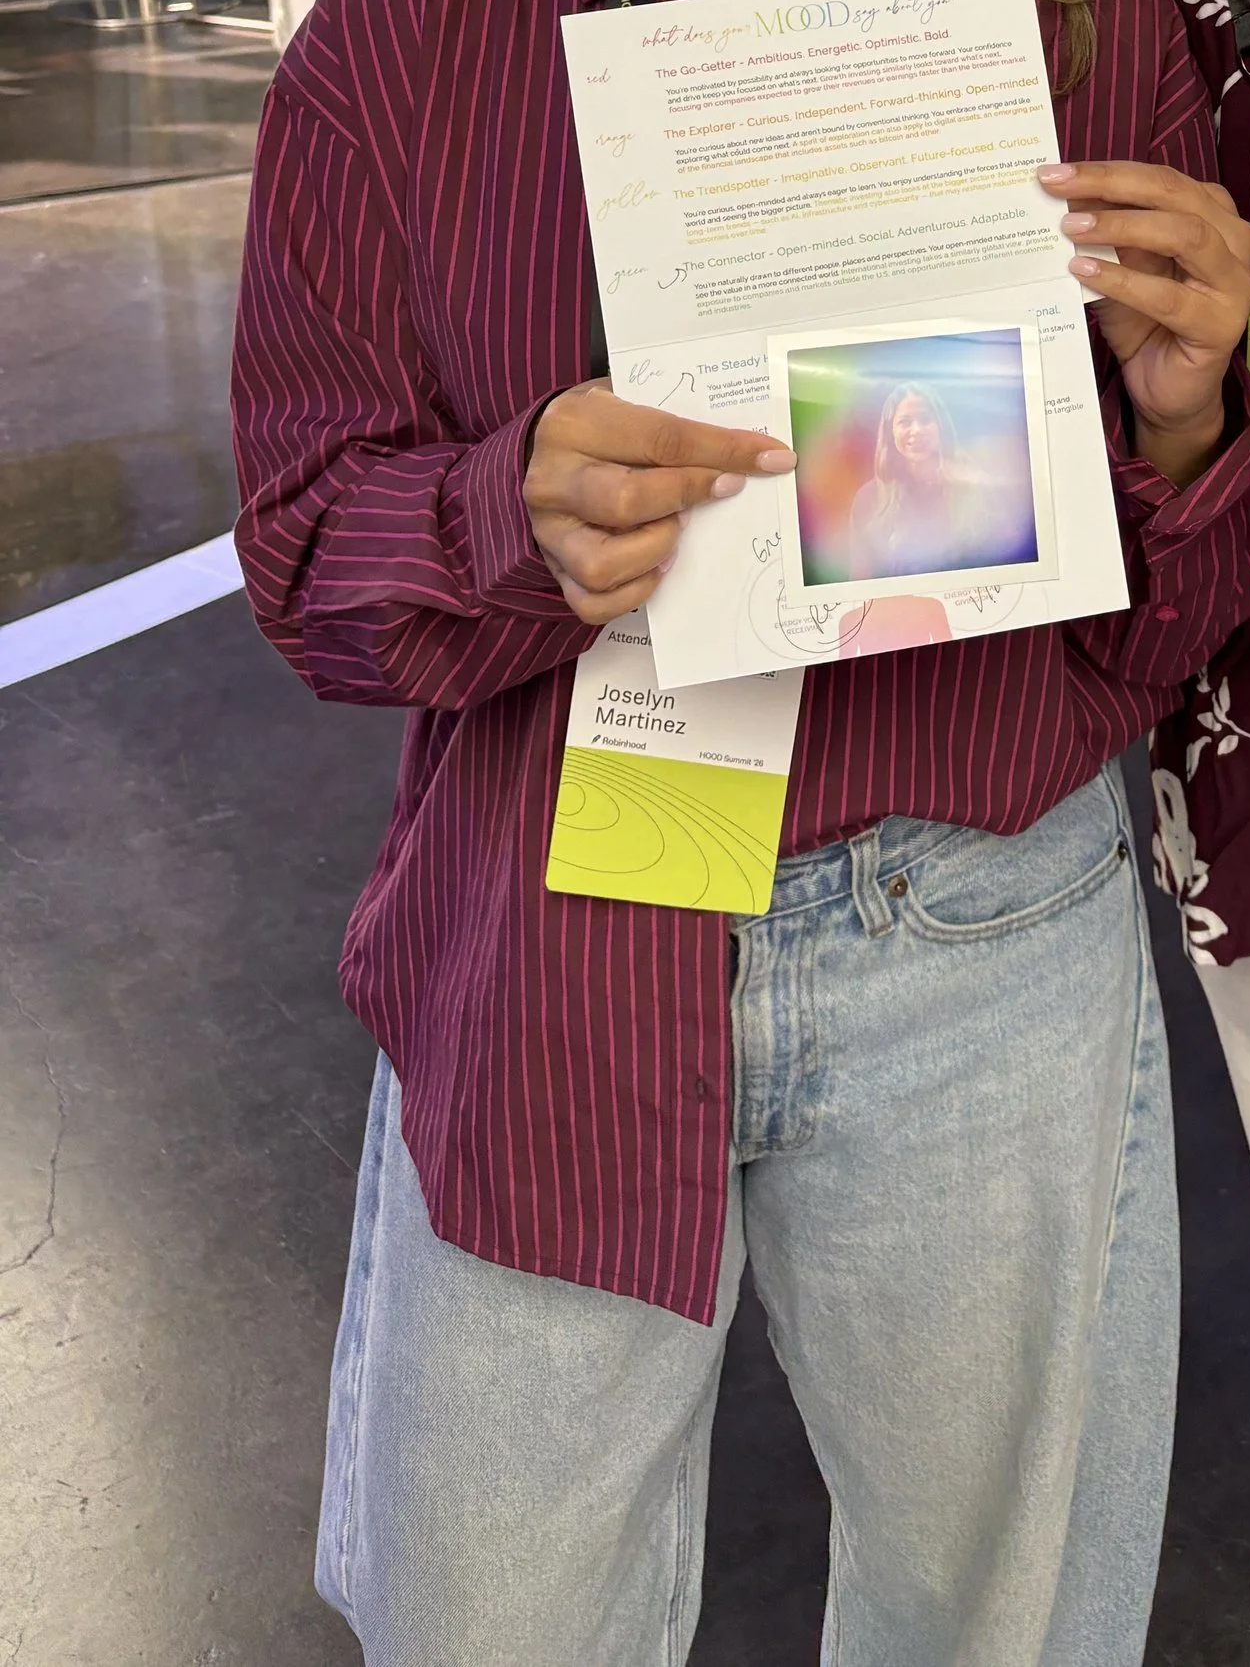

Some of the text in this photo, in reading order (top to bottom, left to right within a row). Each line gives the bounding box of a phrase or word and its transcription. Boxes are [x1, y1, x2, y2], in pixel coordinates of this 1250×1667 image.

[641, 25, 679, 49] what
[754, 1, 850, 36] MOOD
[852, 4, 880, 32] say
[654, 67, 678, 79] The
[678, 59, 737, 76] Go-Getter
[746, 49, 803, 67] Ambitious.
[806, 41, 863, 58] Energetic.
[863, 32, 922, 51] Optimistic.
[922, 28, 950, 42] Bold.
[585, 68, 611, 84] red
[662, 127, 687, 140] The
[687, 120, 737, 137] Explorer
[745, 112, 793, 127] Curious.
[793, 100, 868, 121] Independent.
[868, 87, 962, 109] Forward-thinking.
[671, 188, 696, 200] The
[696, 176, 771, 196] Trendspotter
[780, 165, 848, 183] Imaginative.
[848, 154, 908, 173] Observant.
[997, 135, 1041, 150] Curious.
[681, 260, 706, 274] The
[706, 250, 767, 268] Connector
[775, 234, 855, 258] Open-minded.
[857, 228, 895, 244] Social.
[606, 265, 649, 295] green
[1050, 323, 1075, 333] staying
[696, 356, 760, 375] The Steady
[707, 383, 722, 391] You
[723, 380, 742, 389] value
[708, 385, 766, 401] grounded when
[709, 399, 738, 410] income
[739, 397, 754, 405] and
[1056, 396, 1070, 405] and
[597, 683, 676, 710] Joselyn
[595, 706, 687, 735] Martinez
[602, 736, 647, 751] Robinhood
[724, 755, 752, 766] Summit
